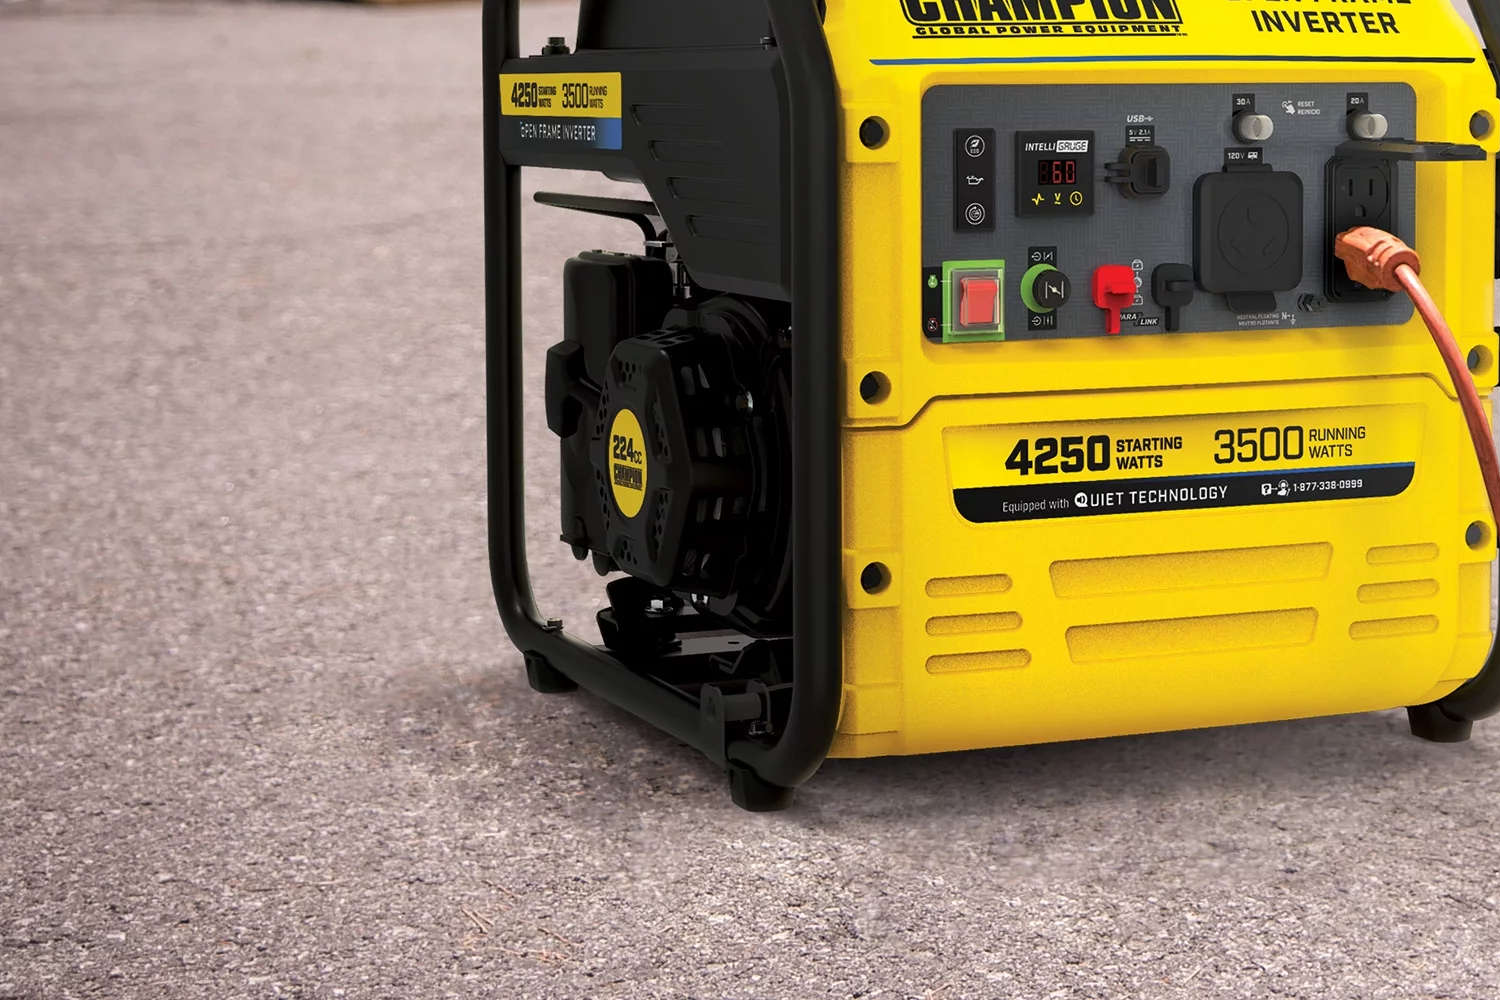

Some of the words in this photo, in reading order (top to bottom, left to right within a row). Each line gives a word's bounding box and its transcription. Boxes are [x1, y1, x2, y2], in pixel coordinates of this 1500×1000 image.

[915, 25, 991, 35] GLOBAL
[997, 25, 1064, 34] POWER
[1073, 25, 1180, 34] EQUIPMENT
[1251, 10, 1400, 34] INVERTER
[511, 82, 538, 108] 4250
[562, 83, 588, 109] 3500
[1126, 114, 1145, 123] USB
[539, 124, 561, 140] FRAME
[562, 124, 597, 141] INVERTER
[1004, 434, 1111, 475] 4250
[1116, 436, 1183, 452] STARTING
[1214, 425, 1304, 464] 3500
[1309, 426, 1366, 441] RUNNING
[1115, 455, 1163, 470] WATTS
[1308, 443, 1353, 458] WATTS
[1002, 500, 1046, 513] Equipped
[1049, 498, 1070, 510] with
[1074, 491, 1124, 508] QUIET
[1129, 485, 1228, 504] TECHNOLOGY
